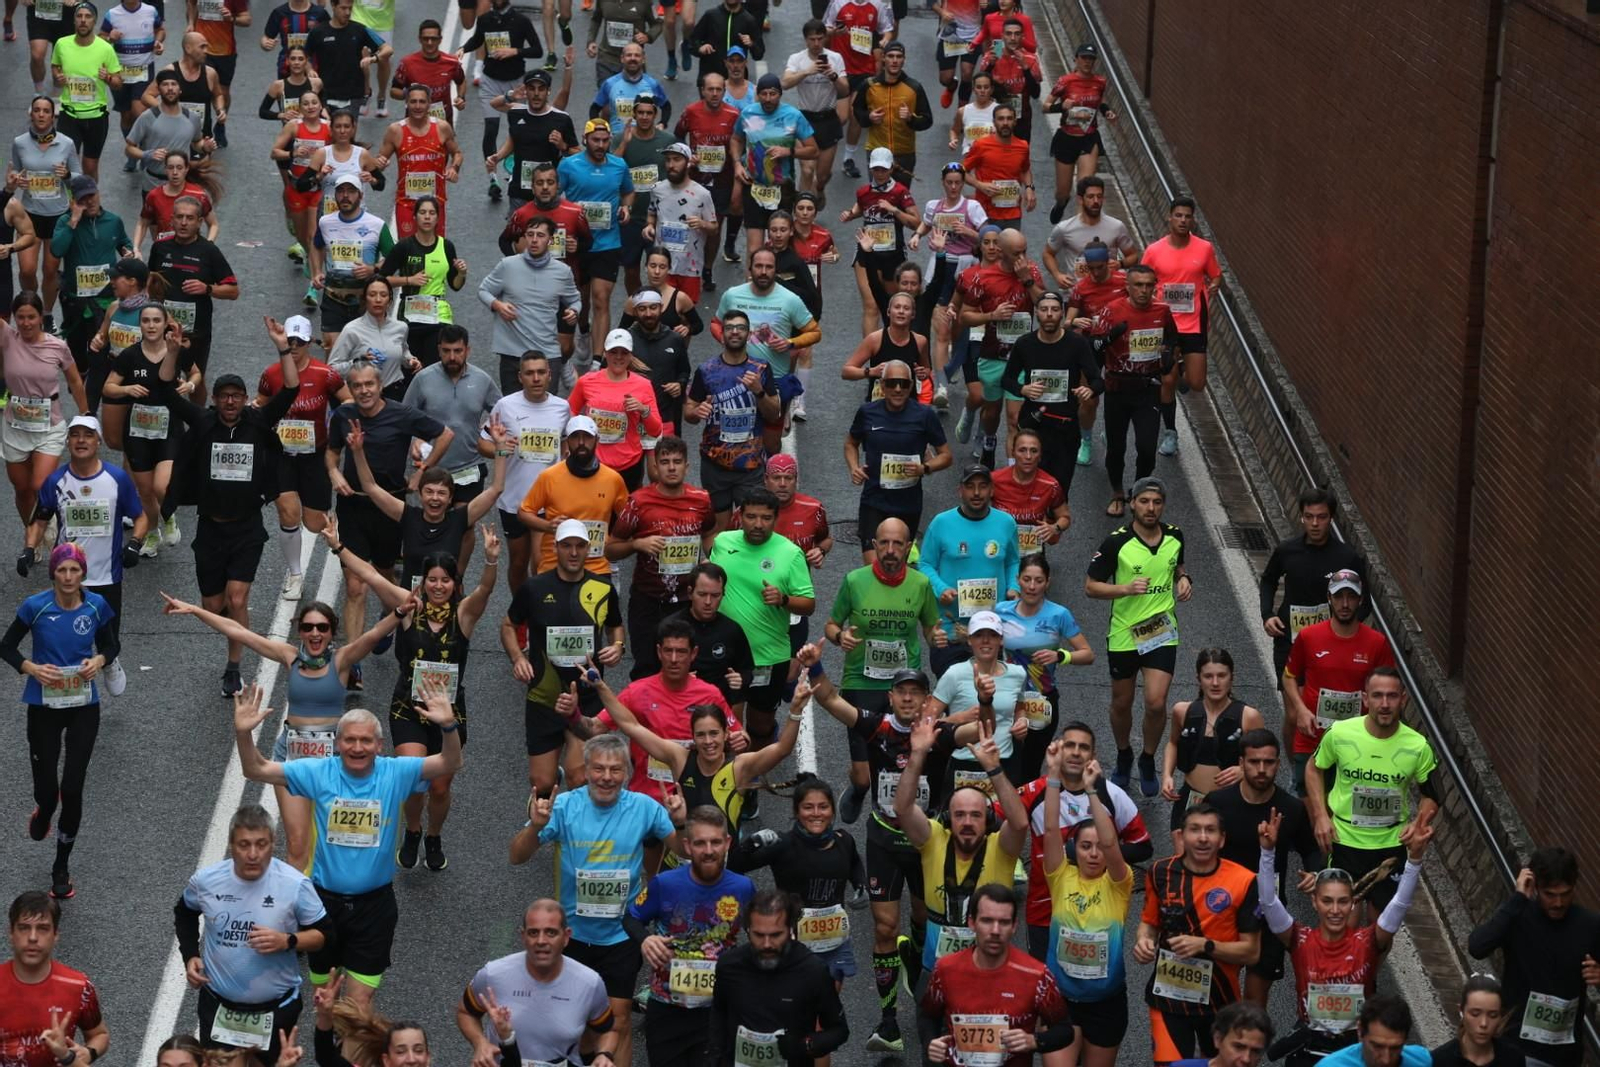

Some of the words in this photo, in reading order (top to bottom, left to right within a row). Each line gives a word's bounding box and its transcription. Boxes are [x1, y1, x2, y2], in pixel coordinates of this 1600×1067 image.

[69, 82, 92, 92] 11621
[619, 103, 634, 113] 120
[30, 178, 55, 188] 11734
[632, 172, 653, 181] 4039
[408, 179, 431, 189] 10784
[585, 208, 604, 217] 640
[331, 247, 357, 257] 11821
[79, 272, 104, 284] 11788
[1164, 290, 1190, 301] 16004
[1132, 337, 1159, 350] 14023
[1036, 378, 1060, 388] 790
[726, 416, 748, 427] 2320
[280, 428, 308, 440] 12858
[522, 436, 553, 448] 11317
[214, 451, 247, 465] 16832
[72, 508, 100, 521] 8615
[663, 546, 694, 559] 12231
[961, 588, 992, 601] 14258
[868, 618, 907, 632] sano
[555, 636, 583, 649] 7420
[872, 650, 899, 663] 6798
[1024, 702, 1045, 714] 034
[1324, 700, 1353, 714] 9453
[290, 741, 325, 756] 17824
[1343, 768, 1389, 783] adidas
[1358, 796, 1390, 811] 7801
[332, 811, 372, 826] 12271
[580, 881, 621, 897] 10224
[802, 917, 842, 934] 13937
[1064, 941, 1096, 958] 7553
[1160, 962, 1202, 984] 14489
[674, 971, 716, 989] 14158
[1316, 995, 1352, 1012] 8952
[223, 1008, 261, 1026] 8579
[960, 1027, 995, 1044] 3773
[741, 1042, 774, 1061] 6763
